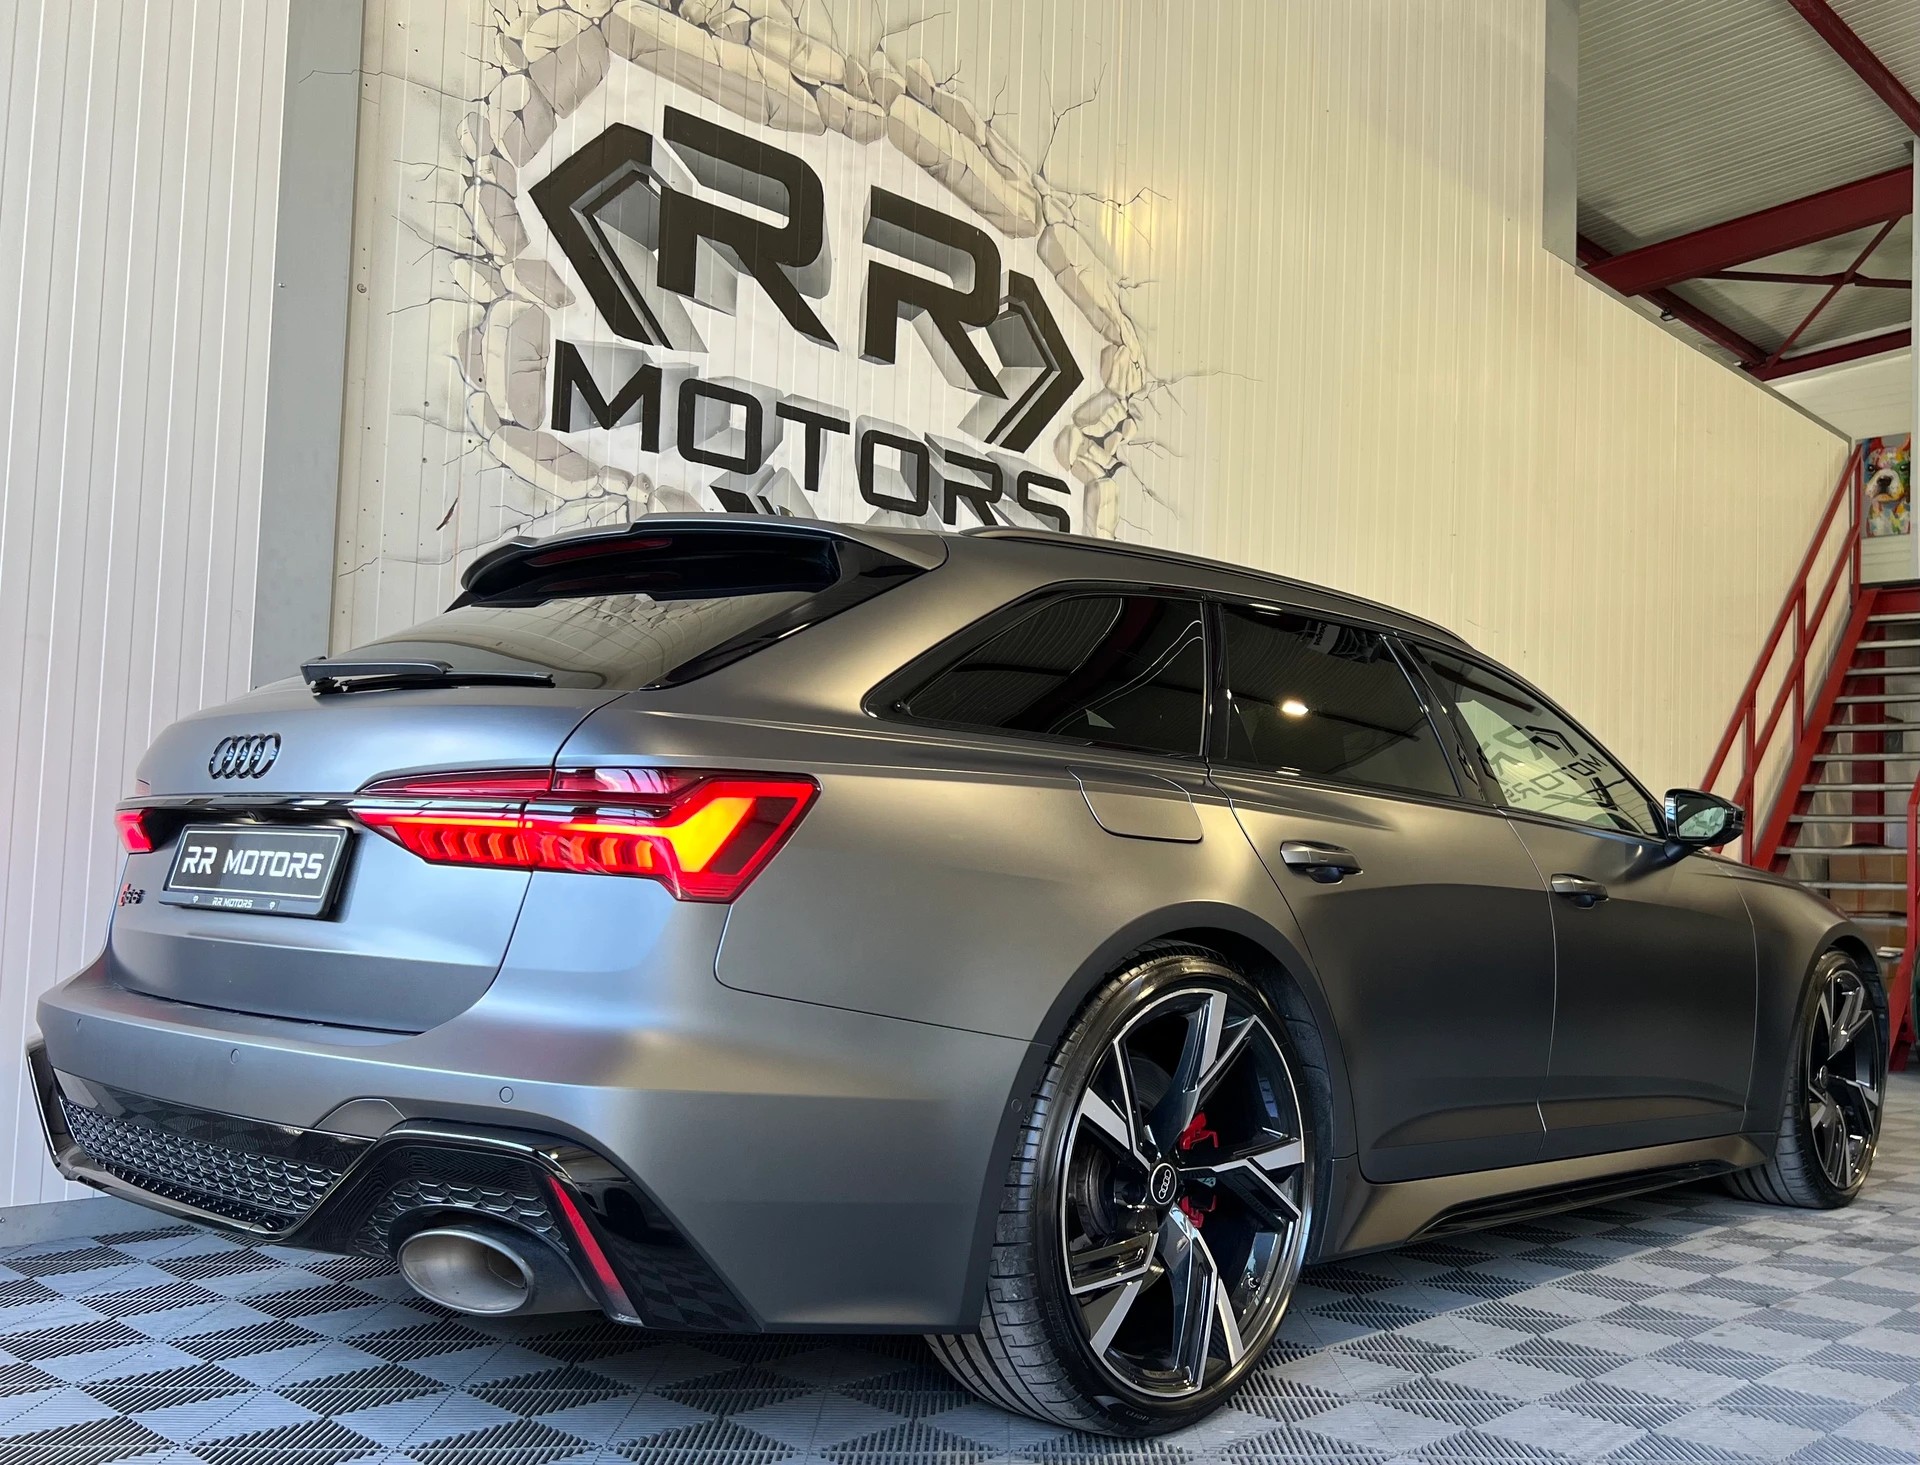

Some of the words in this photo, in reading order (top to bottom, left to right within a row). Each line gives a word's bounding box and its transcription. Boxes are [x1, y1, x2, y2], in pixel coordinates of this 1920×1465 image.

[656, 104, 1010, 400] RR
[552, 339, 1072, 535] MOTORS
[181, 846, 218, 875] RR
[222, 849, 325, 880] MOTORS
[212, 896, 223, 906] RR
[223, 897, 253, 909] MOTORS
